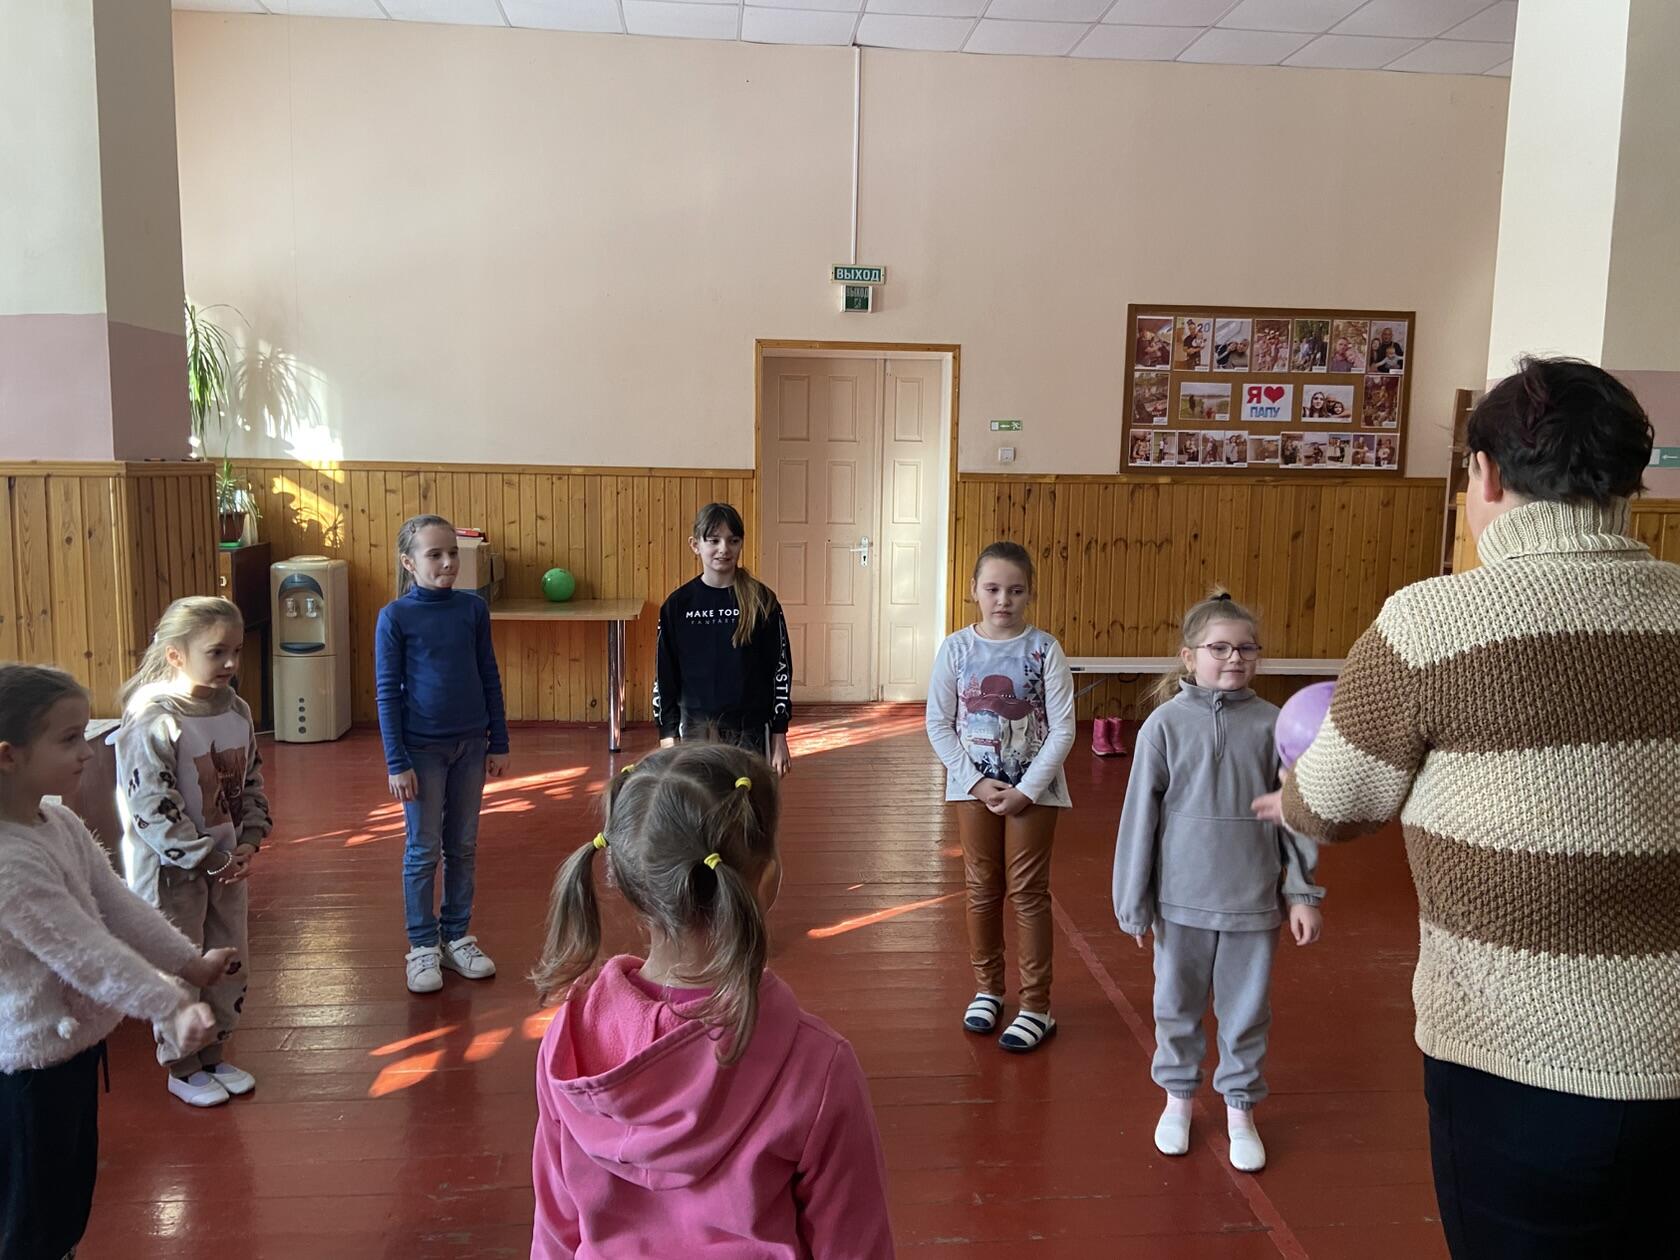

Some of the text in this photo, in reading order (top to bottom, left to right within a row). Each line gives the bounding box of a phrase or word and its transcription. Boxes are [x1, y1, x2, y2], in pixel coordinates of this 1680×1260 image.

[836, 268, 880, 282] ВЫХОД
[1247, 386, 1262, 404] Я
[1250, 406, 1280, 418] ПАПУ
[685, 608, 740, 619] MAKE TOD
